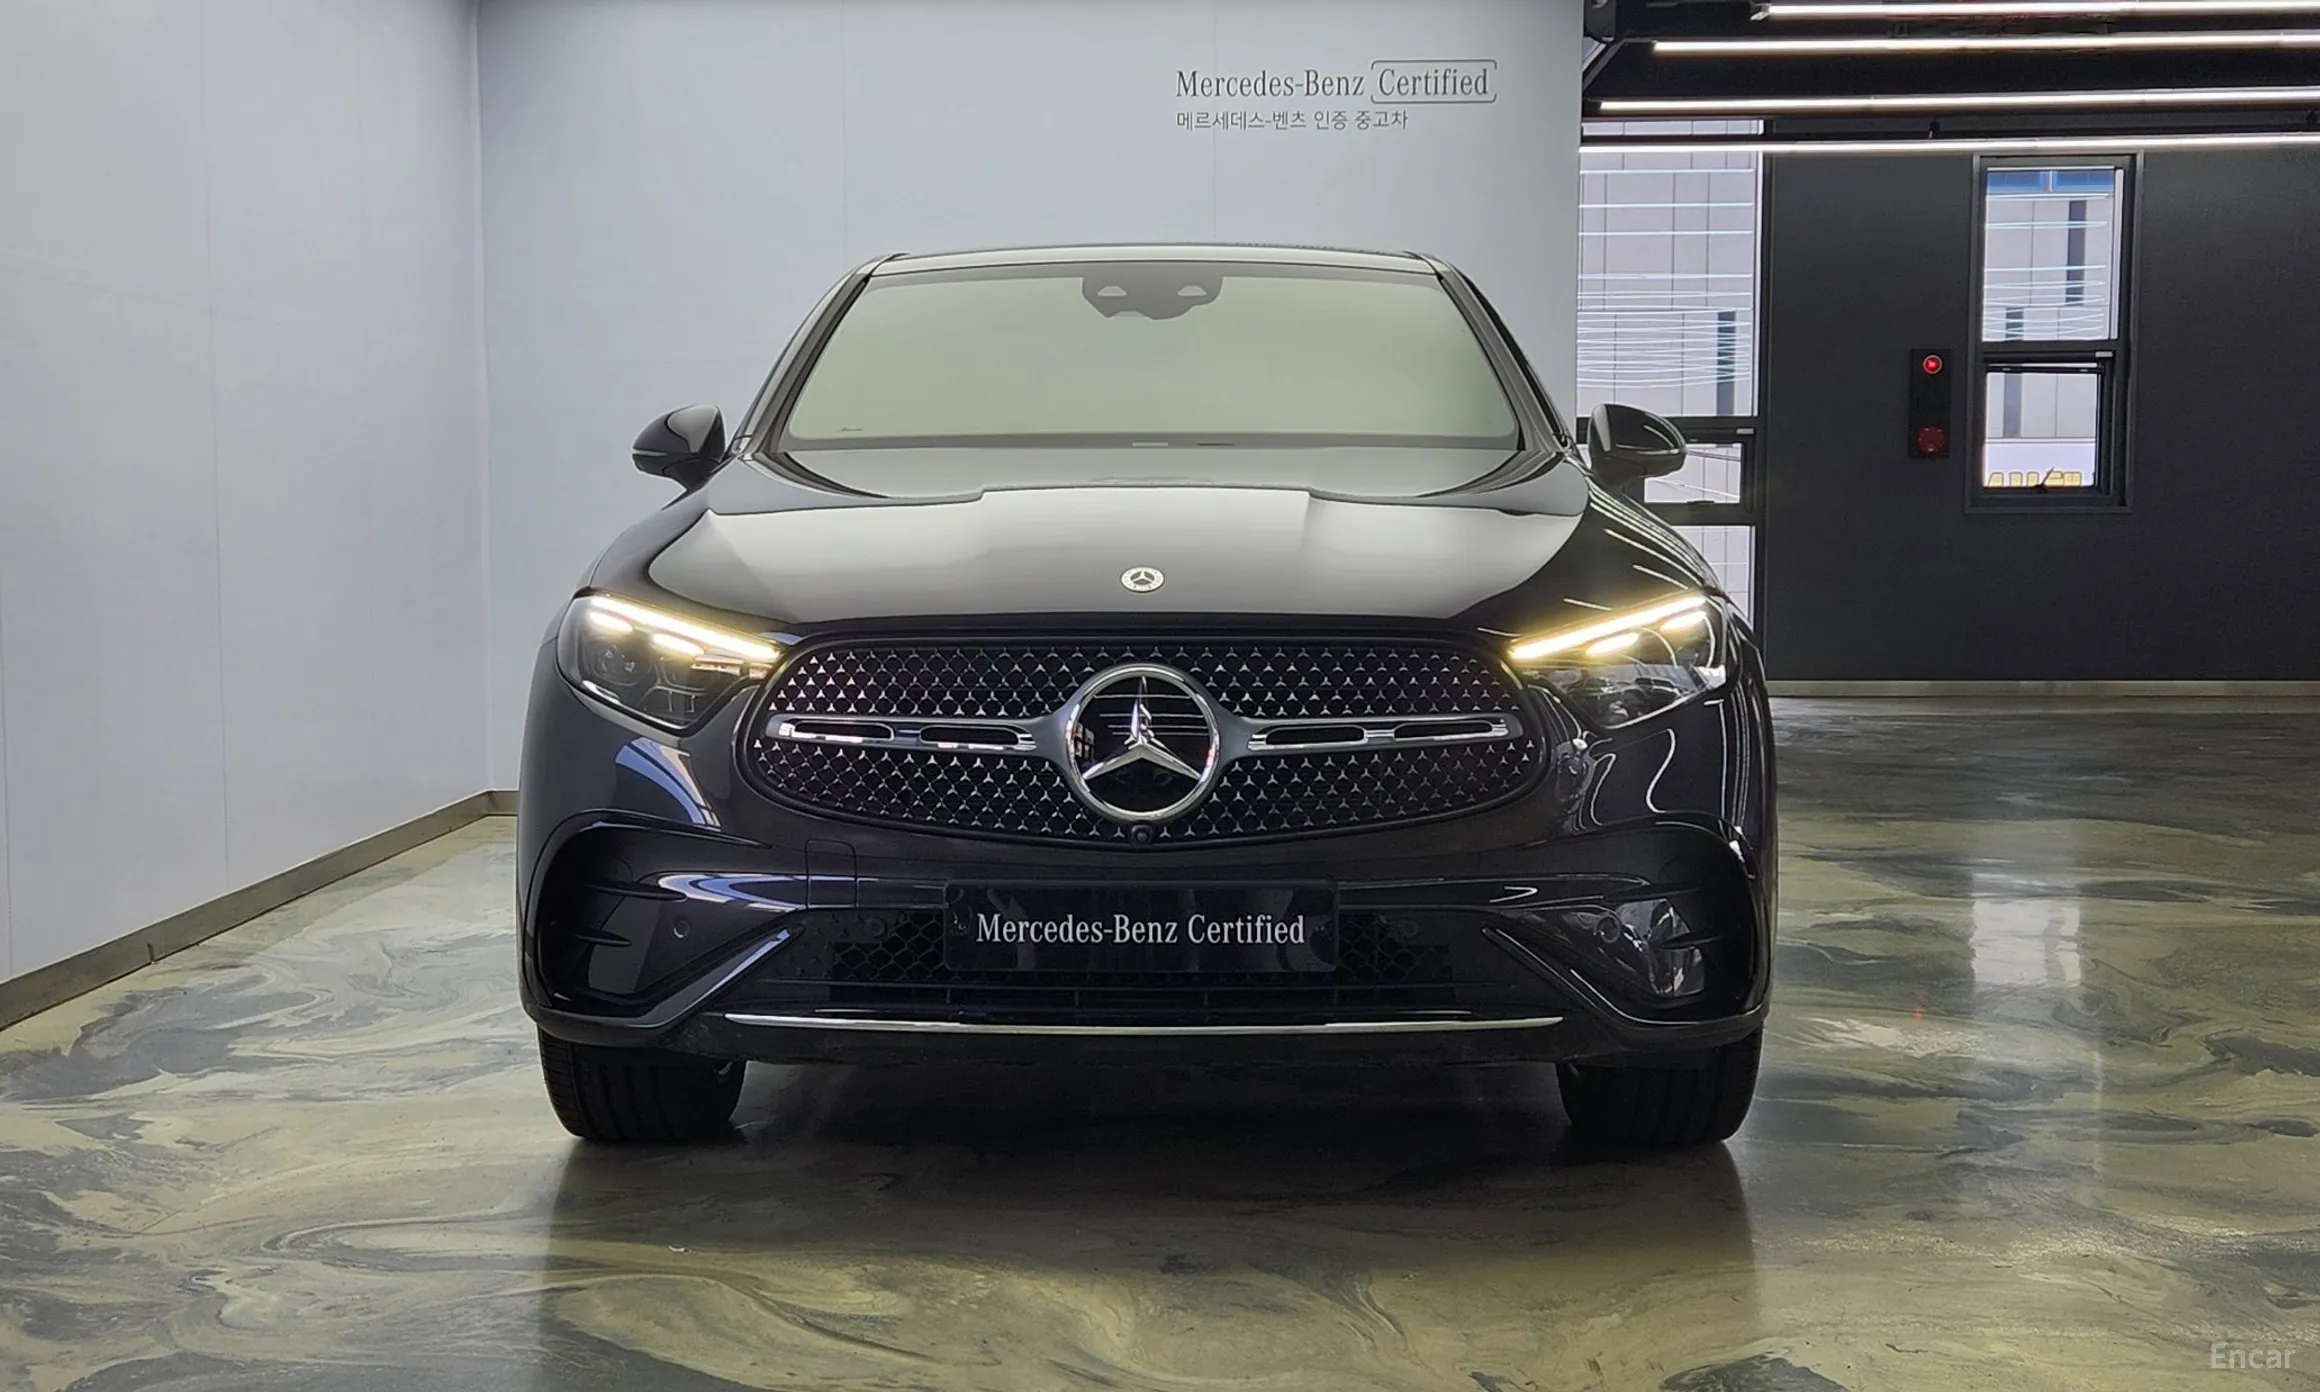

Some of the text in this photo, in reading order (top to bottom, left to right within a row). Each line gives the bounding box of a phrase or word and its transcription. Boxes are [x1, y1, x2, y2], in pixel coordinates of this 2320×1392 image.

[1175, 67, 1489, 98] Mercedes-Benz Certified
[1176, 110, 1409, 131] 메르세데스-벤츠 인증 중고차
[976, 912, 1306, 945] Mercedes-Benz Certified
